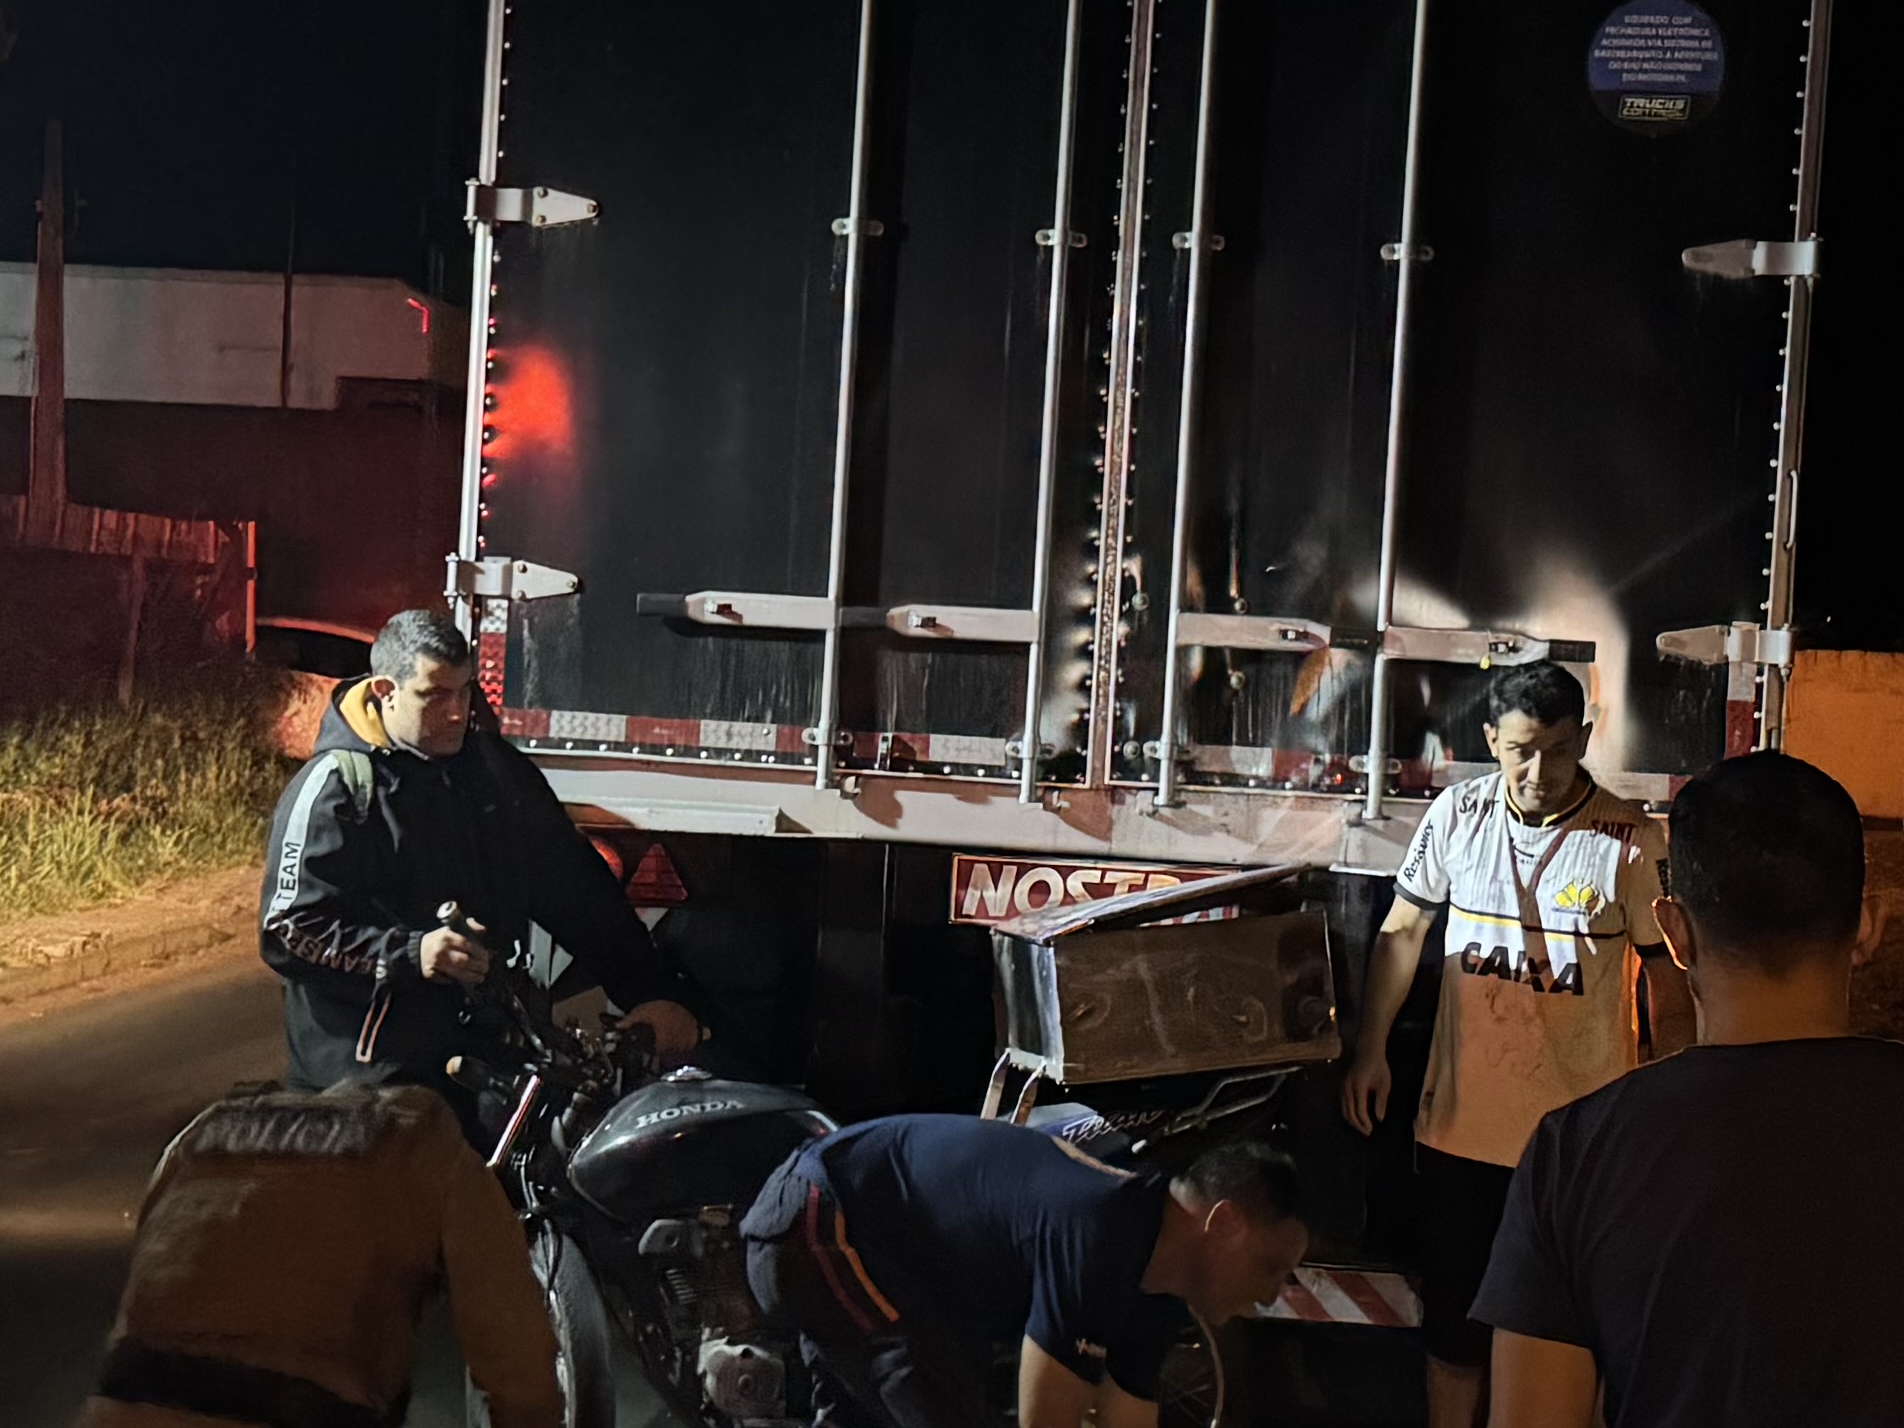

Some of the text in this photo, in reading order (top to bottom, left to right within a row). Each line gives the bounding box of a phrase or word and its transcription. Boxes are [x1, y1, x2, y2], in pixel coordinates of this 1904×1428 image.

[1589, 819, 1636, 843] SAINT
[1461, 941, 1584, 996] CAIXA
[636, 1100, 744, 1129] HONDA
